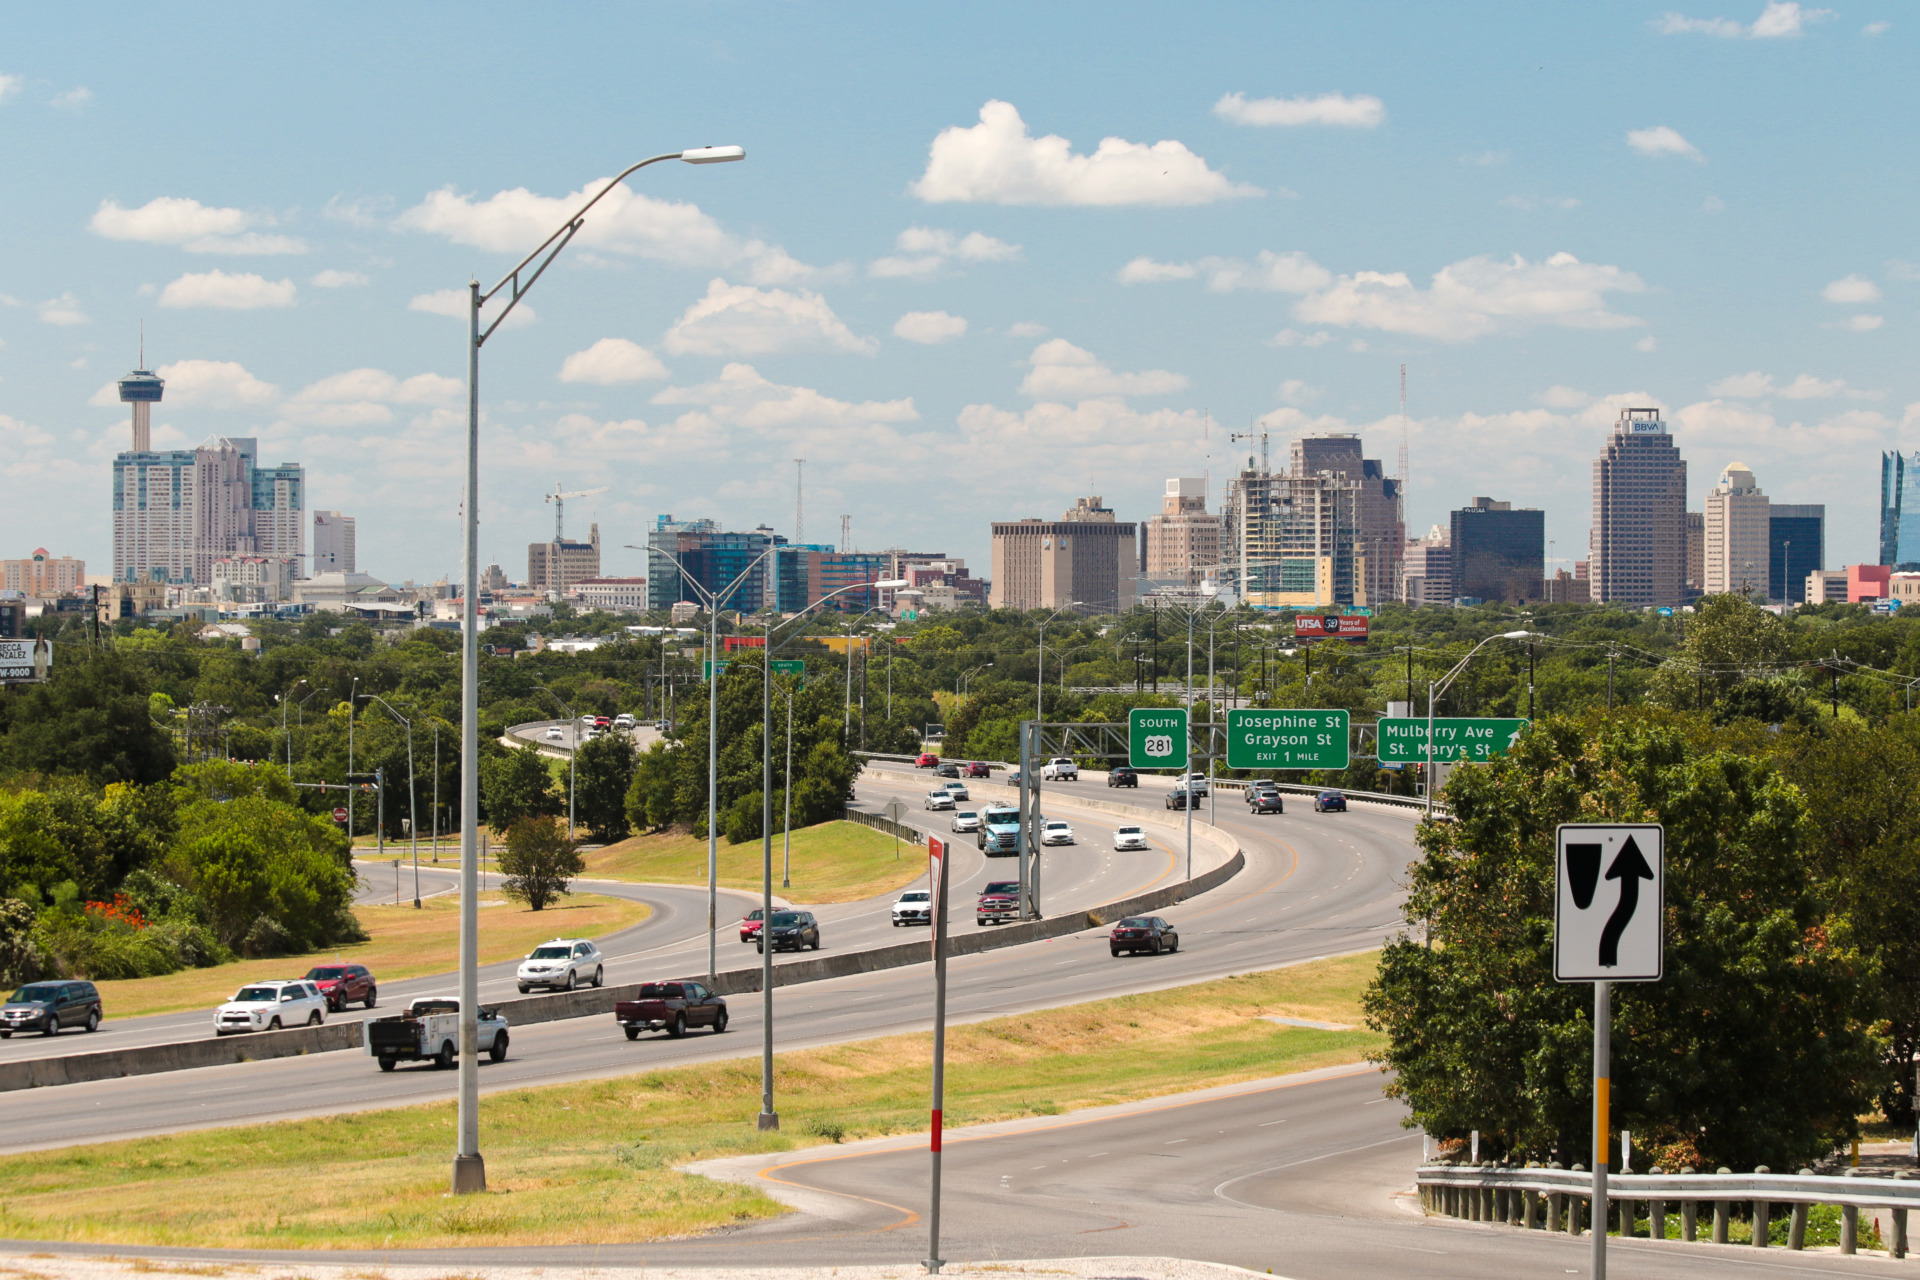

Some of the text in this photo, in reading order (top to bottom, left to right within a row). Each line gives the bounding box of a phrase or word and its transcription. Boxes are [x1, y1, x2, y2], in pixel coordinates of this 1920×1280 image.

[1635, 423, 1658, 431] BBVA
[1296, 619, 1322, 628] UTSA
[1139, 719, 1178, 728] SOUTH
[1236, 715, 1341, 730] Josephine St
[1465, 726, 1494, 738] Ave
[1147, 739, 1170, 752] 281
[1244, 733, 1332, 748] Grayson St
[1256, 751, 1319, 762] EXIT 1 MILE
[1389, 743, 1491, 758] St. Mary's St
